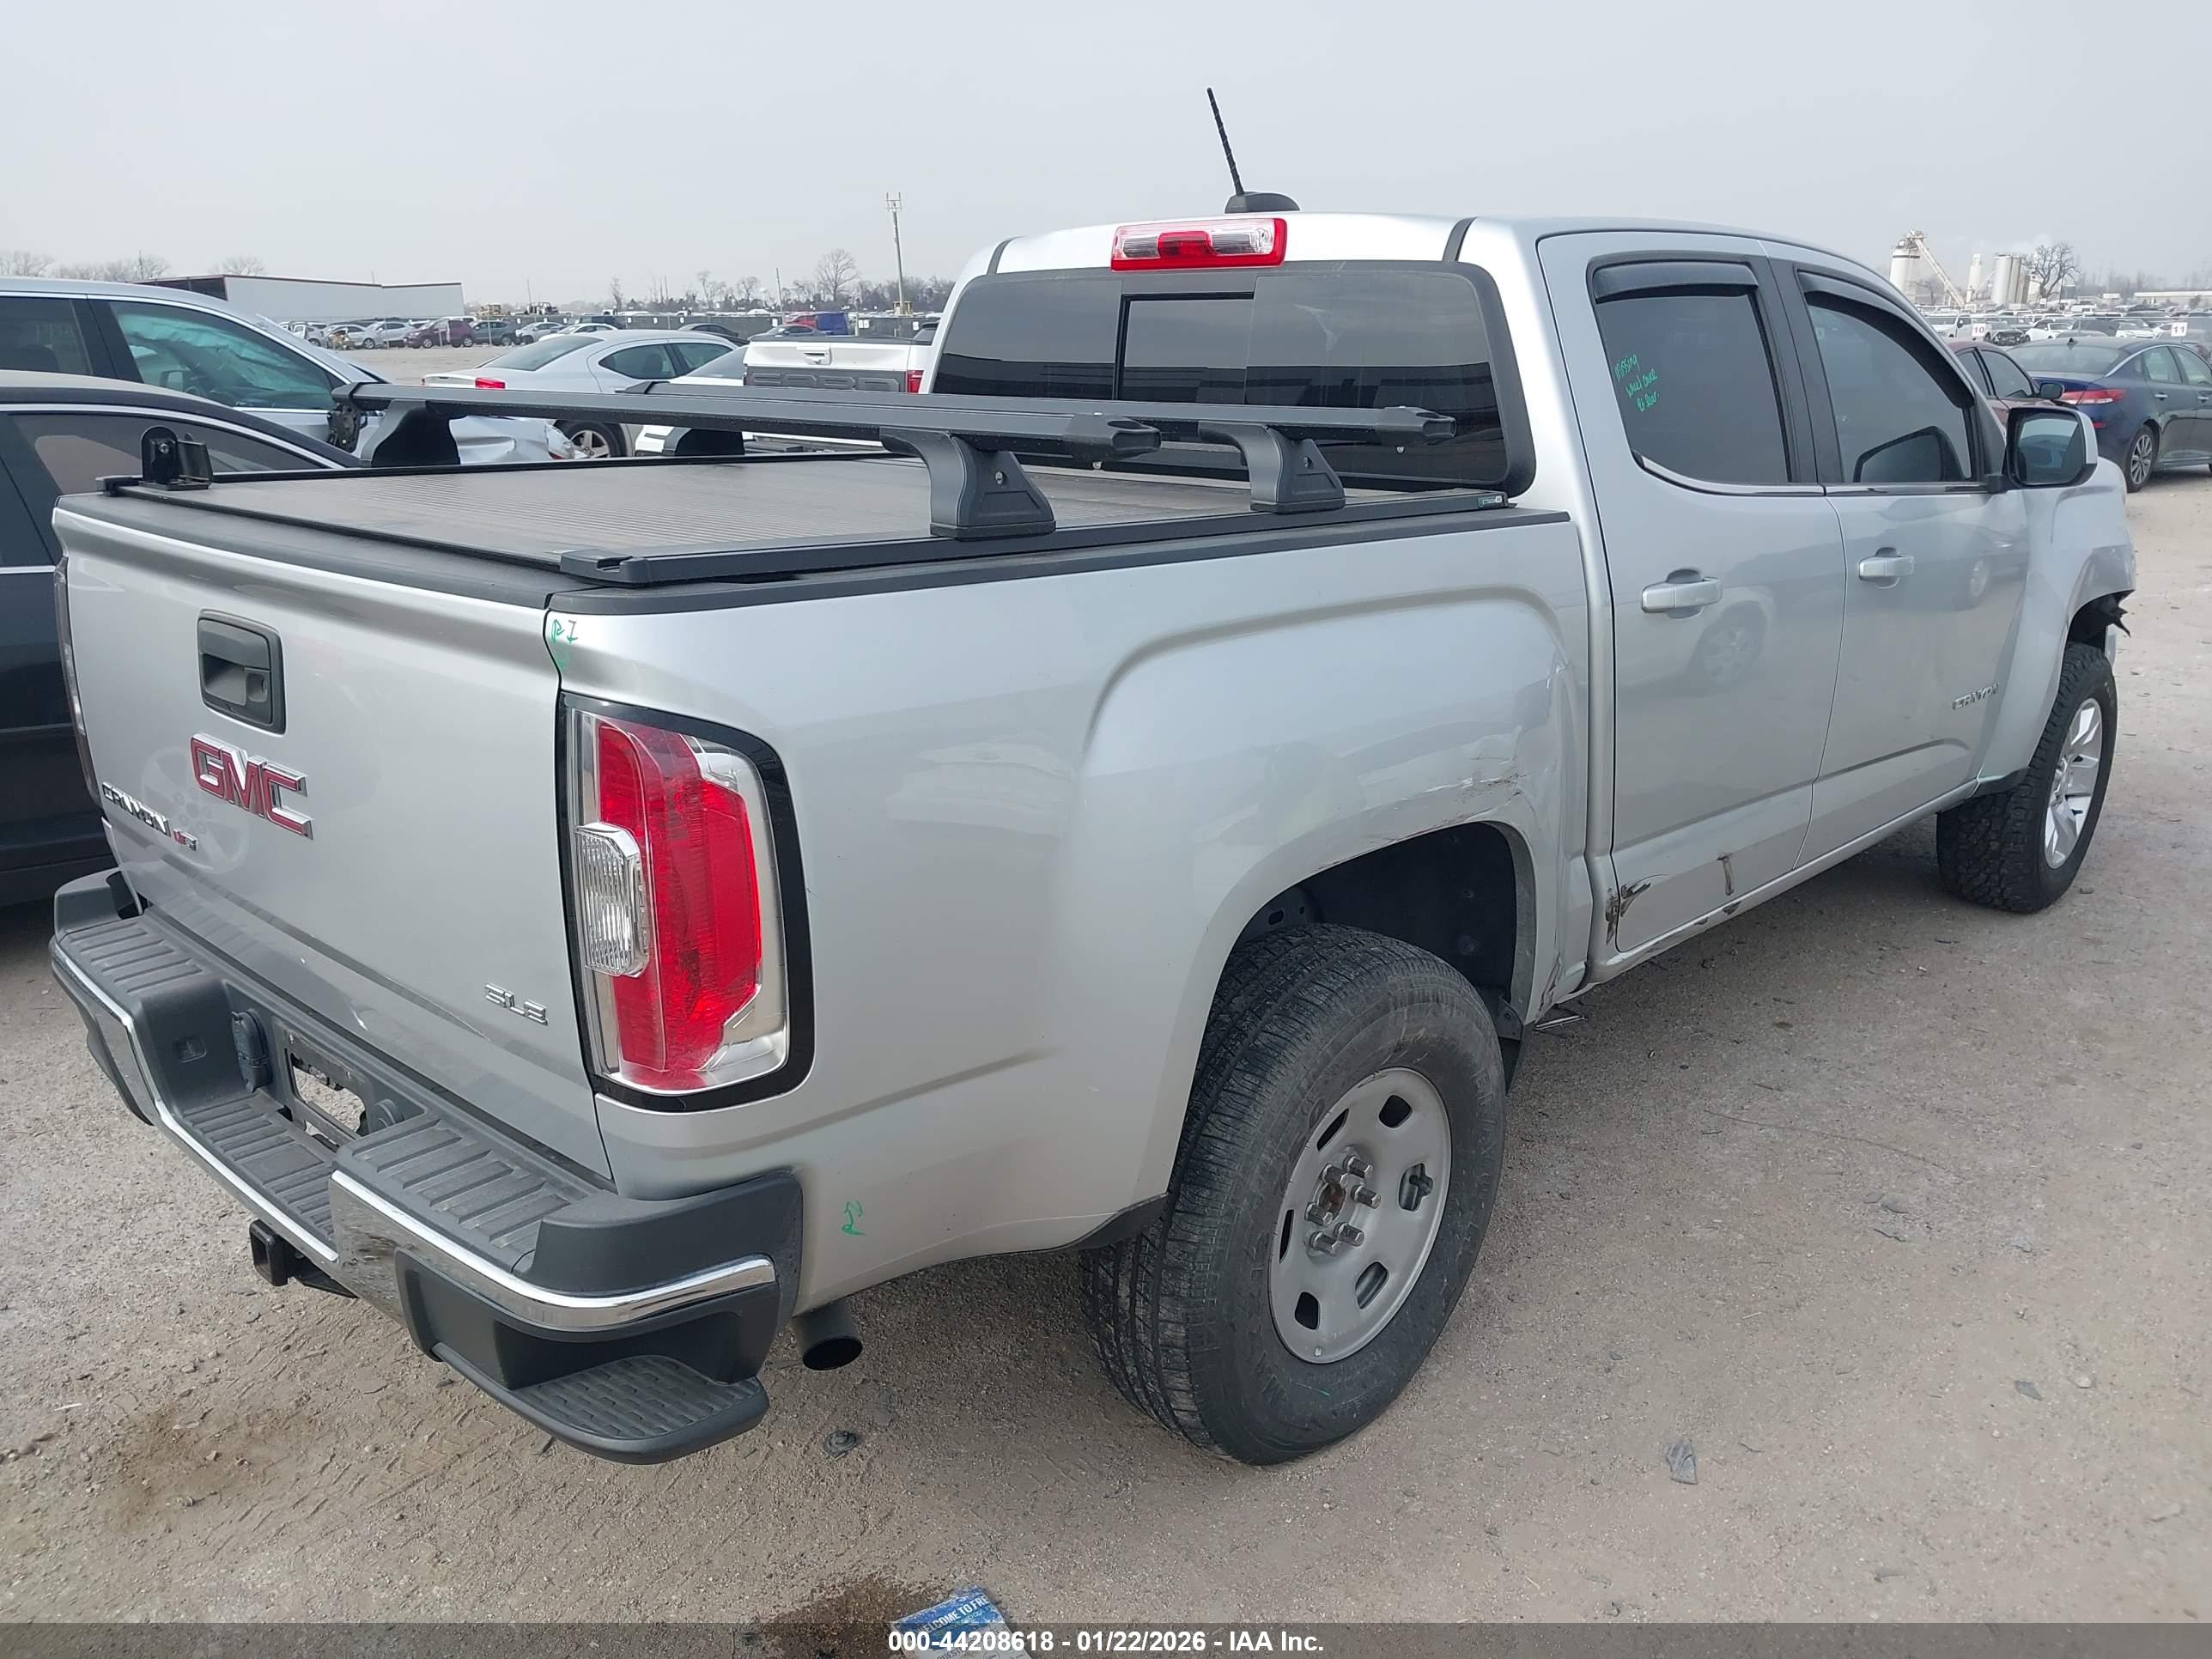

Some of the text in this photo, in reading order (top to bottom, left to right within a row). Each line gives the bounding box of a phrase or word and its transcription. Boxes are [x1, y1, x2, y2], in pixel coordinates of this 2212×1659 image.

[1952, 682, 2000, 710] CANYON
[190, 732, 313, 840] GMC
[102, 781, 172, 837] CANYON
[484, 983, 549, 1026] SLE
[957, 1604, 973, 1615] TO
